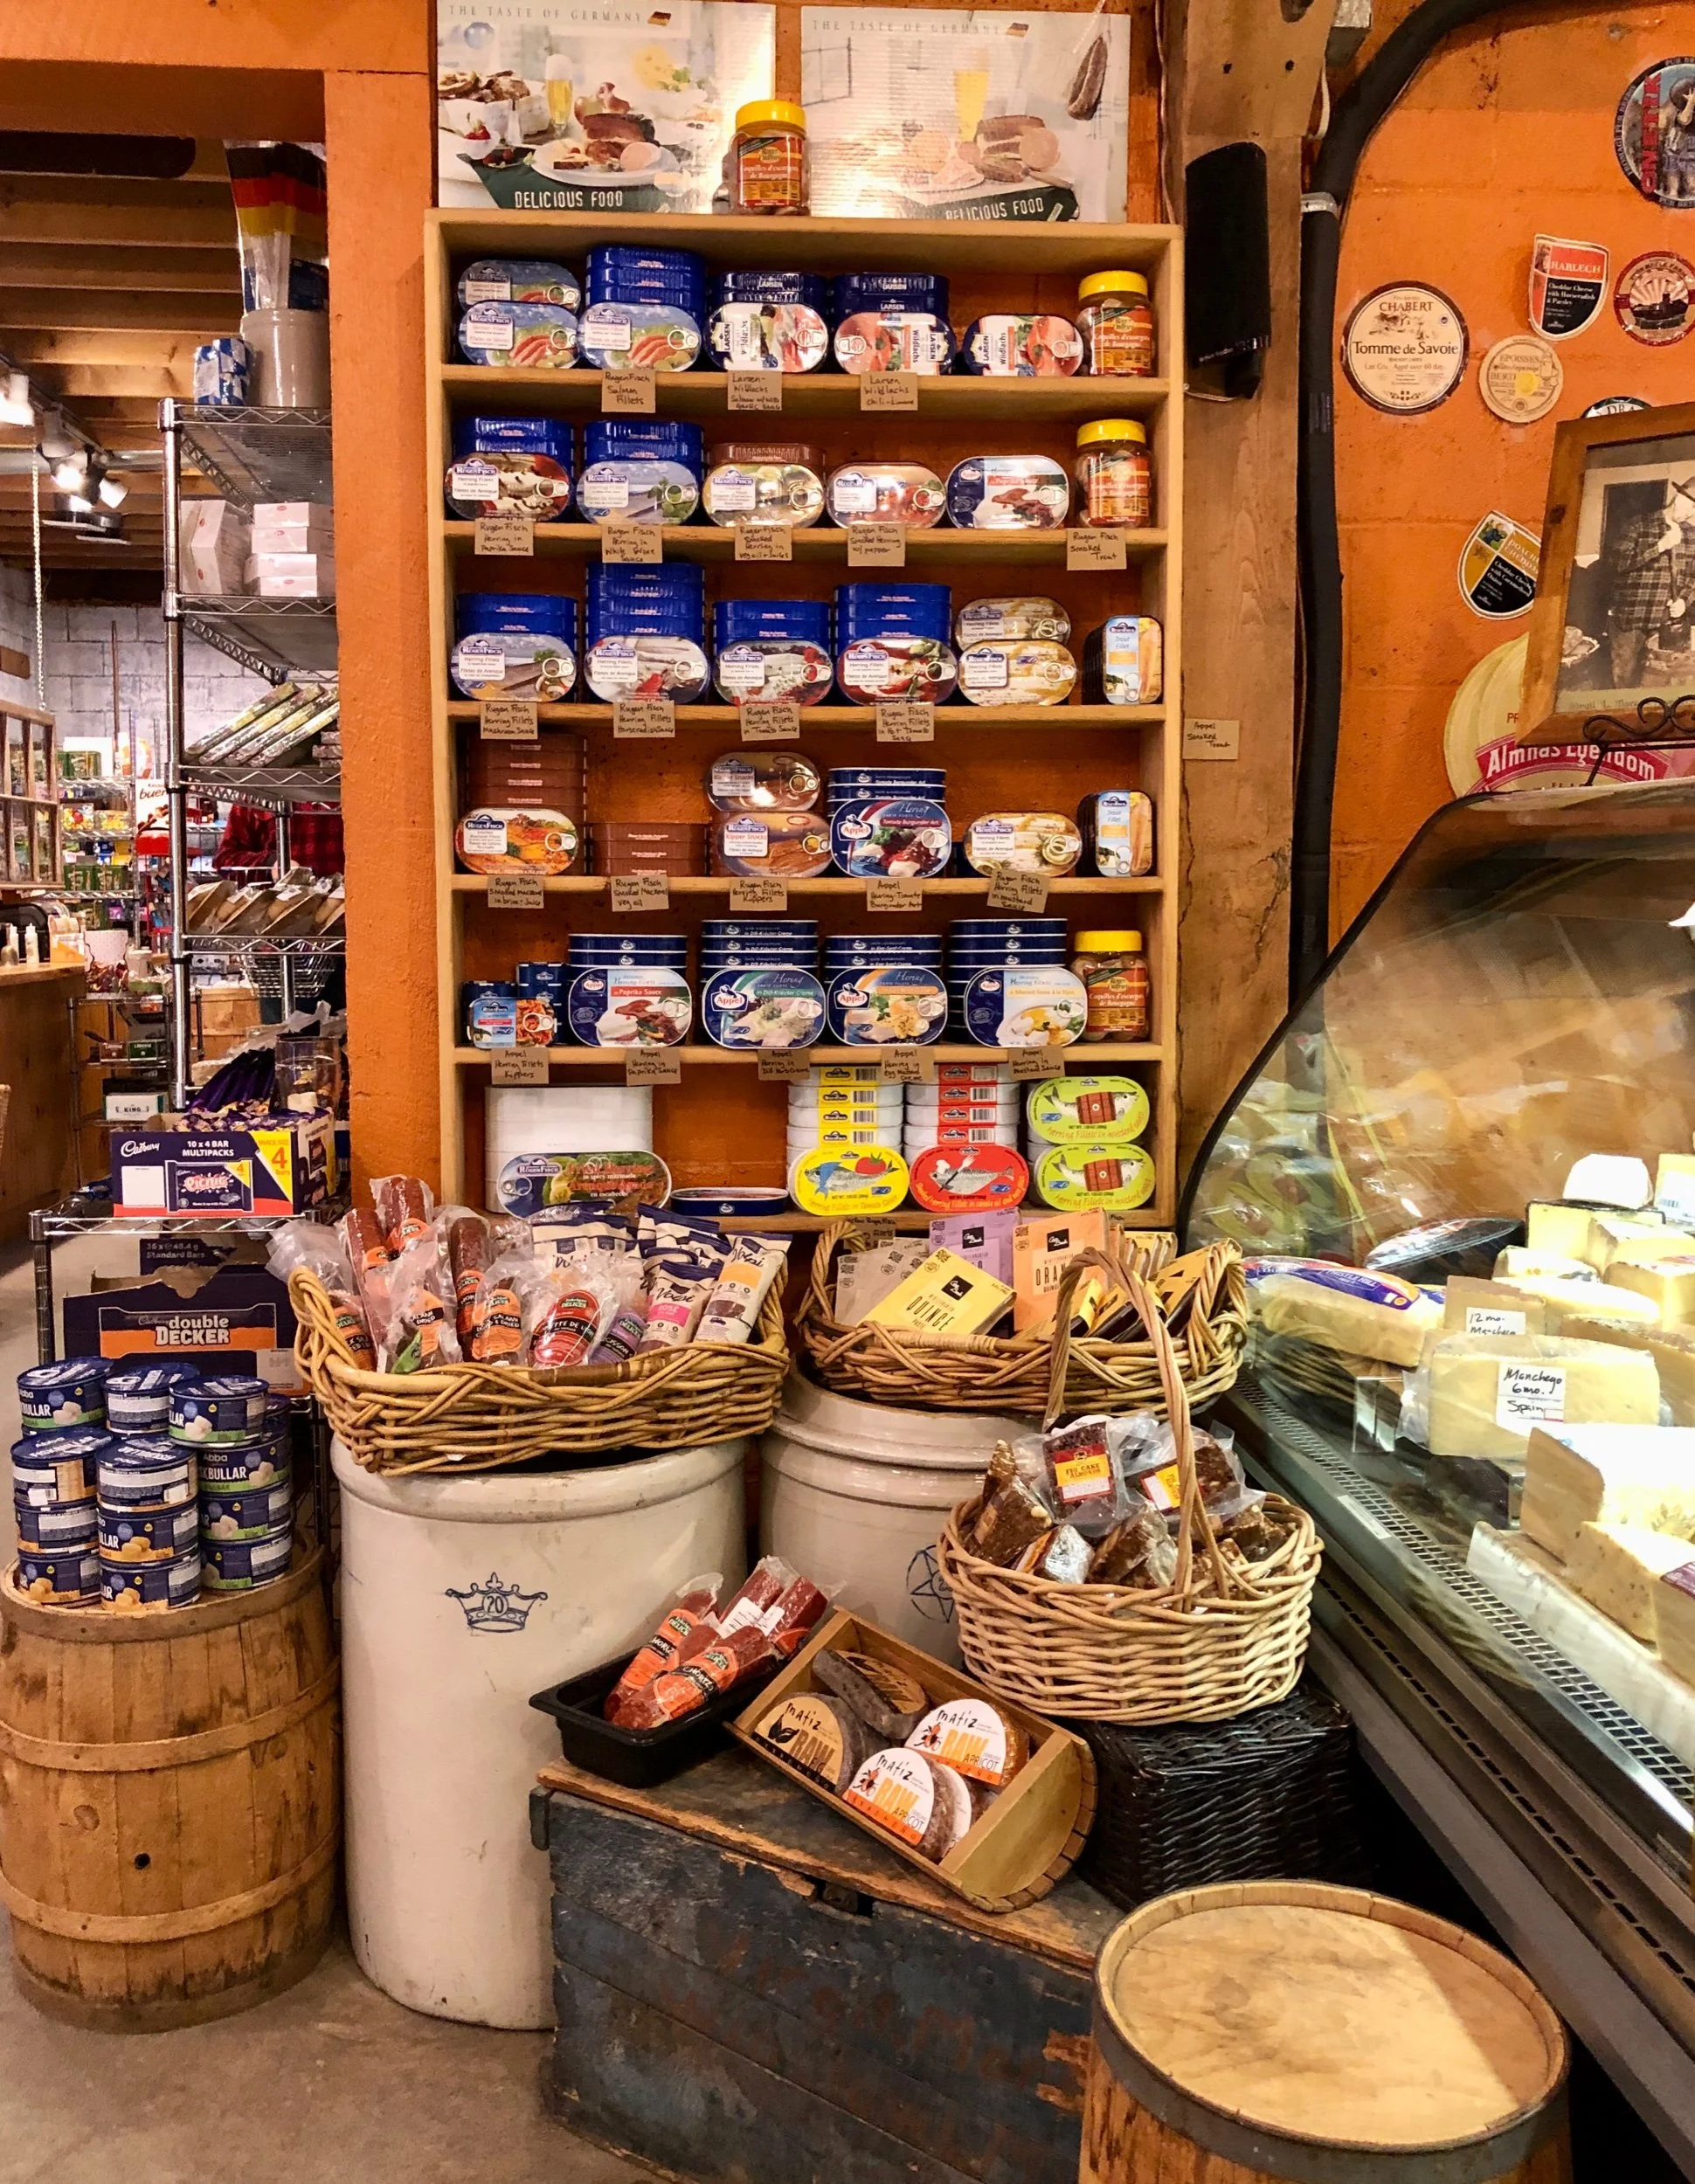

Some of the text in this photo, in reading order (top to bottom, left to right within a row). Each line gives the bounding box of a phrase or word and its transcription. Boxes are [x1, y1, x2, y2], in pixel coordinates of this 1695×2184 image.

[450, 6, 641, 23] THE TASTE OF GERMANY
[813, 20, 841, 31] THE
[515, 191, 623, 208] DELICIOUS FOOD
[1014, 197, 1044, 214] FOOD
[1552, 261, 1601, 273] HARLECH
[1379, 301, 1433, 311] CHABERT
[1353, 342, 1459, 355] Tomme de Savoie
[717, 997, 742, 1006] Appel
[840, 993, 868, 1003] Appel
[121, 1140, 160, 1158] Cadbury
[272, 1147, 287, 1168] 4
[237, 1164, 244, 1173] 4
[1036, 1263, 1066, 1286] ORAN
[906, 1296, 954, 1331] QUINCE
[1470, 1313, 1483, 1324] 12
[169, 1316, 229, 1329] double
[156, 1327, 230, 1345] DECKER
[1504, 1367, 1562, 1394] Manchego
[1507, 1400, 1544, 1414] Spain
[1069, 1469, 1101, 1479] ALMONDS
[487, 1596, 504, 1614] 20
[786, 1702, 821, 1731] matiz
[937, 1710, 979, 1728] matiz
[790, 1729, 835, 1769] RAW
[940, 1729, 990, 1761] RAW
[876, 1755, 913, 1781] matiz
[963, 1753, 1000, 1770] APRICOT
[874, 1777, 920, 1813] RAW
[892, 1807, 925, 1829] APRICOT
